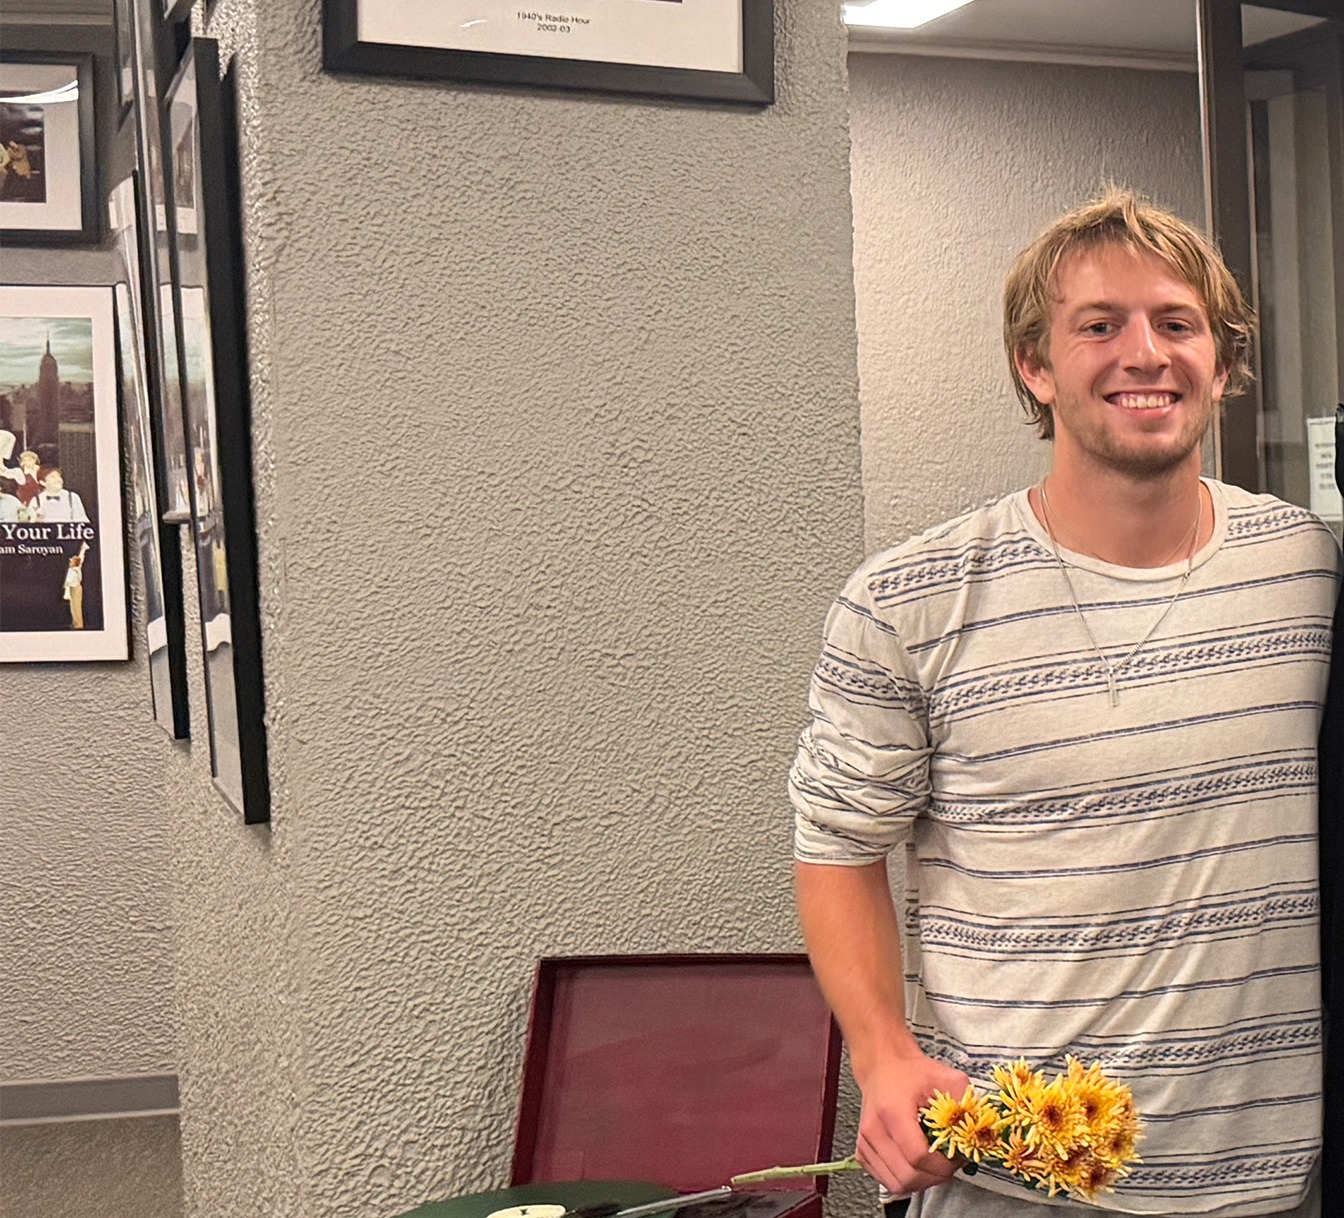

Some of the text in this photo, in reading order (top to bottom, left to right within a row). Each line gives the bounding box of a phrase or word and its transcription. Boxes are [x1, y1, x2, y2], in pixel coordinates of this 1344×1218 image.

[545, 14, 570, 24] Radio
[571, 16, 591, 25] Hour
[2, 522, 95, 541] Your Life
[17, 544, 64, 557] Saroyan
